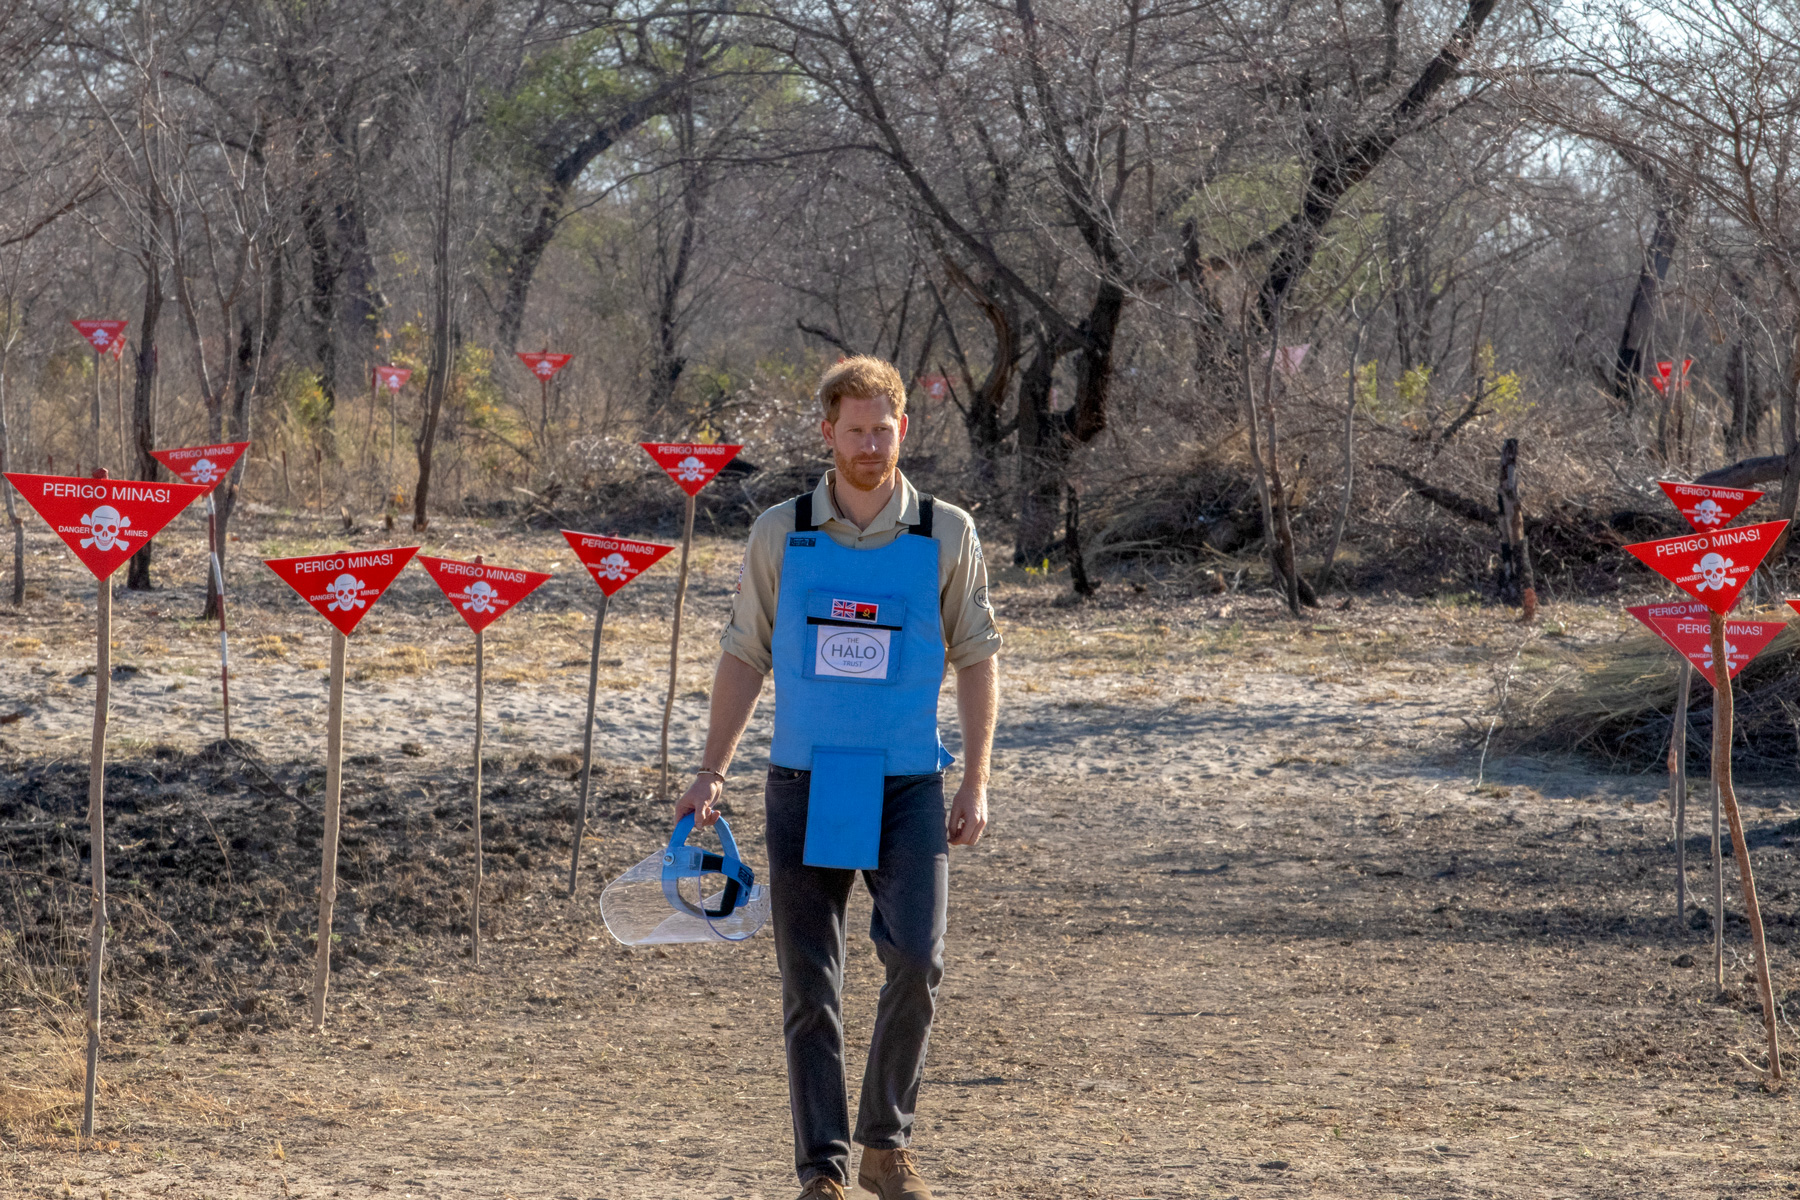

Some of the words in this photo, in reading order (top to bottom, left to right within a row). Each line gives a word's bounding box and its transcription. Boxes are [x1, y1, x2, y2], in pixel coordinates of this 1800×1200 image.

[169, 449, 202, 460] PERIGO
[204, 446, 235, 457] MINAS!
[658, 446, 692, 455] PERIGO
[693, 446, 725, 455] MINAS!
[43, 482, 107, 499] PERIGO
[112, 487, 170, 503] MINAS!
[1675, 486, 1710, 498] PERIGO
[1711, 489, 1744, 501] MINAS!
[58, 525, 90, 534] DANGER
[124, 529, 148, 537] MINES
[581, 537, 619, 550] PERIGO
[620, 543, 655, 555] MINAS!
[1656, 538, 1709, 557] PERIGO
[1712, 529, 1761, 547] MINAS!
[294, 558, 345, 574] PERIGO
[348, 553, 394, 569] MINAS!
[439, 562, 484, 578] PERIGO
[486, 568, 527, 583] MINAS!
[1676, 573, 1703, 583] DANGER
[1729, 566, 1750, 575] MINES
[309, 593, 335, 602] DANGER
[360, 588, 380, 597] MINES
[448, 592, 471, 600] DANGER
[1648, 606, 1687, 617] PERIGO
[1677, 624, 1711, 634] PERIG
[831, 644, 877, 660] HALO
